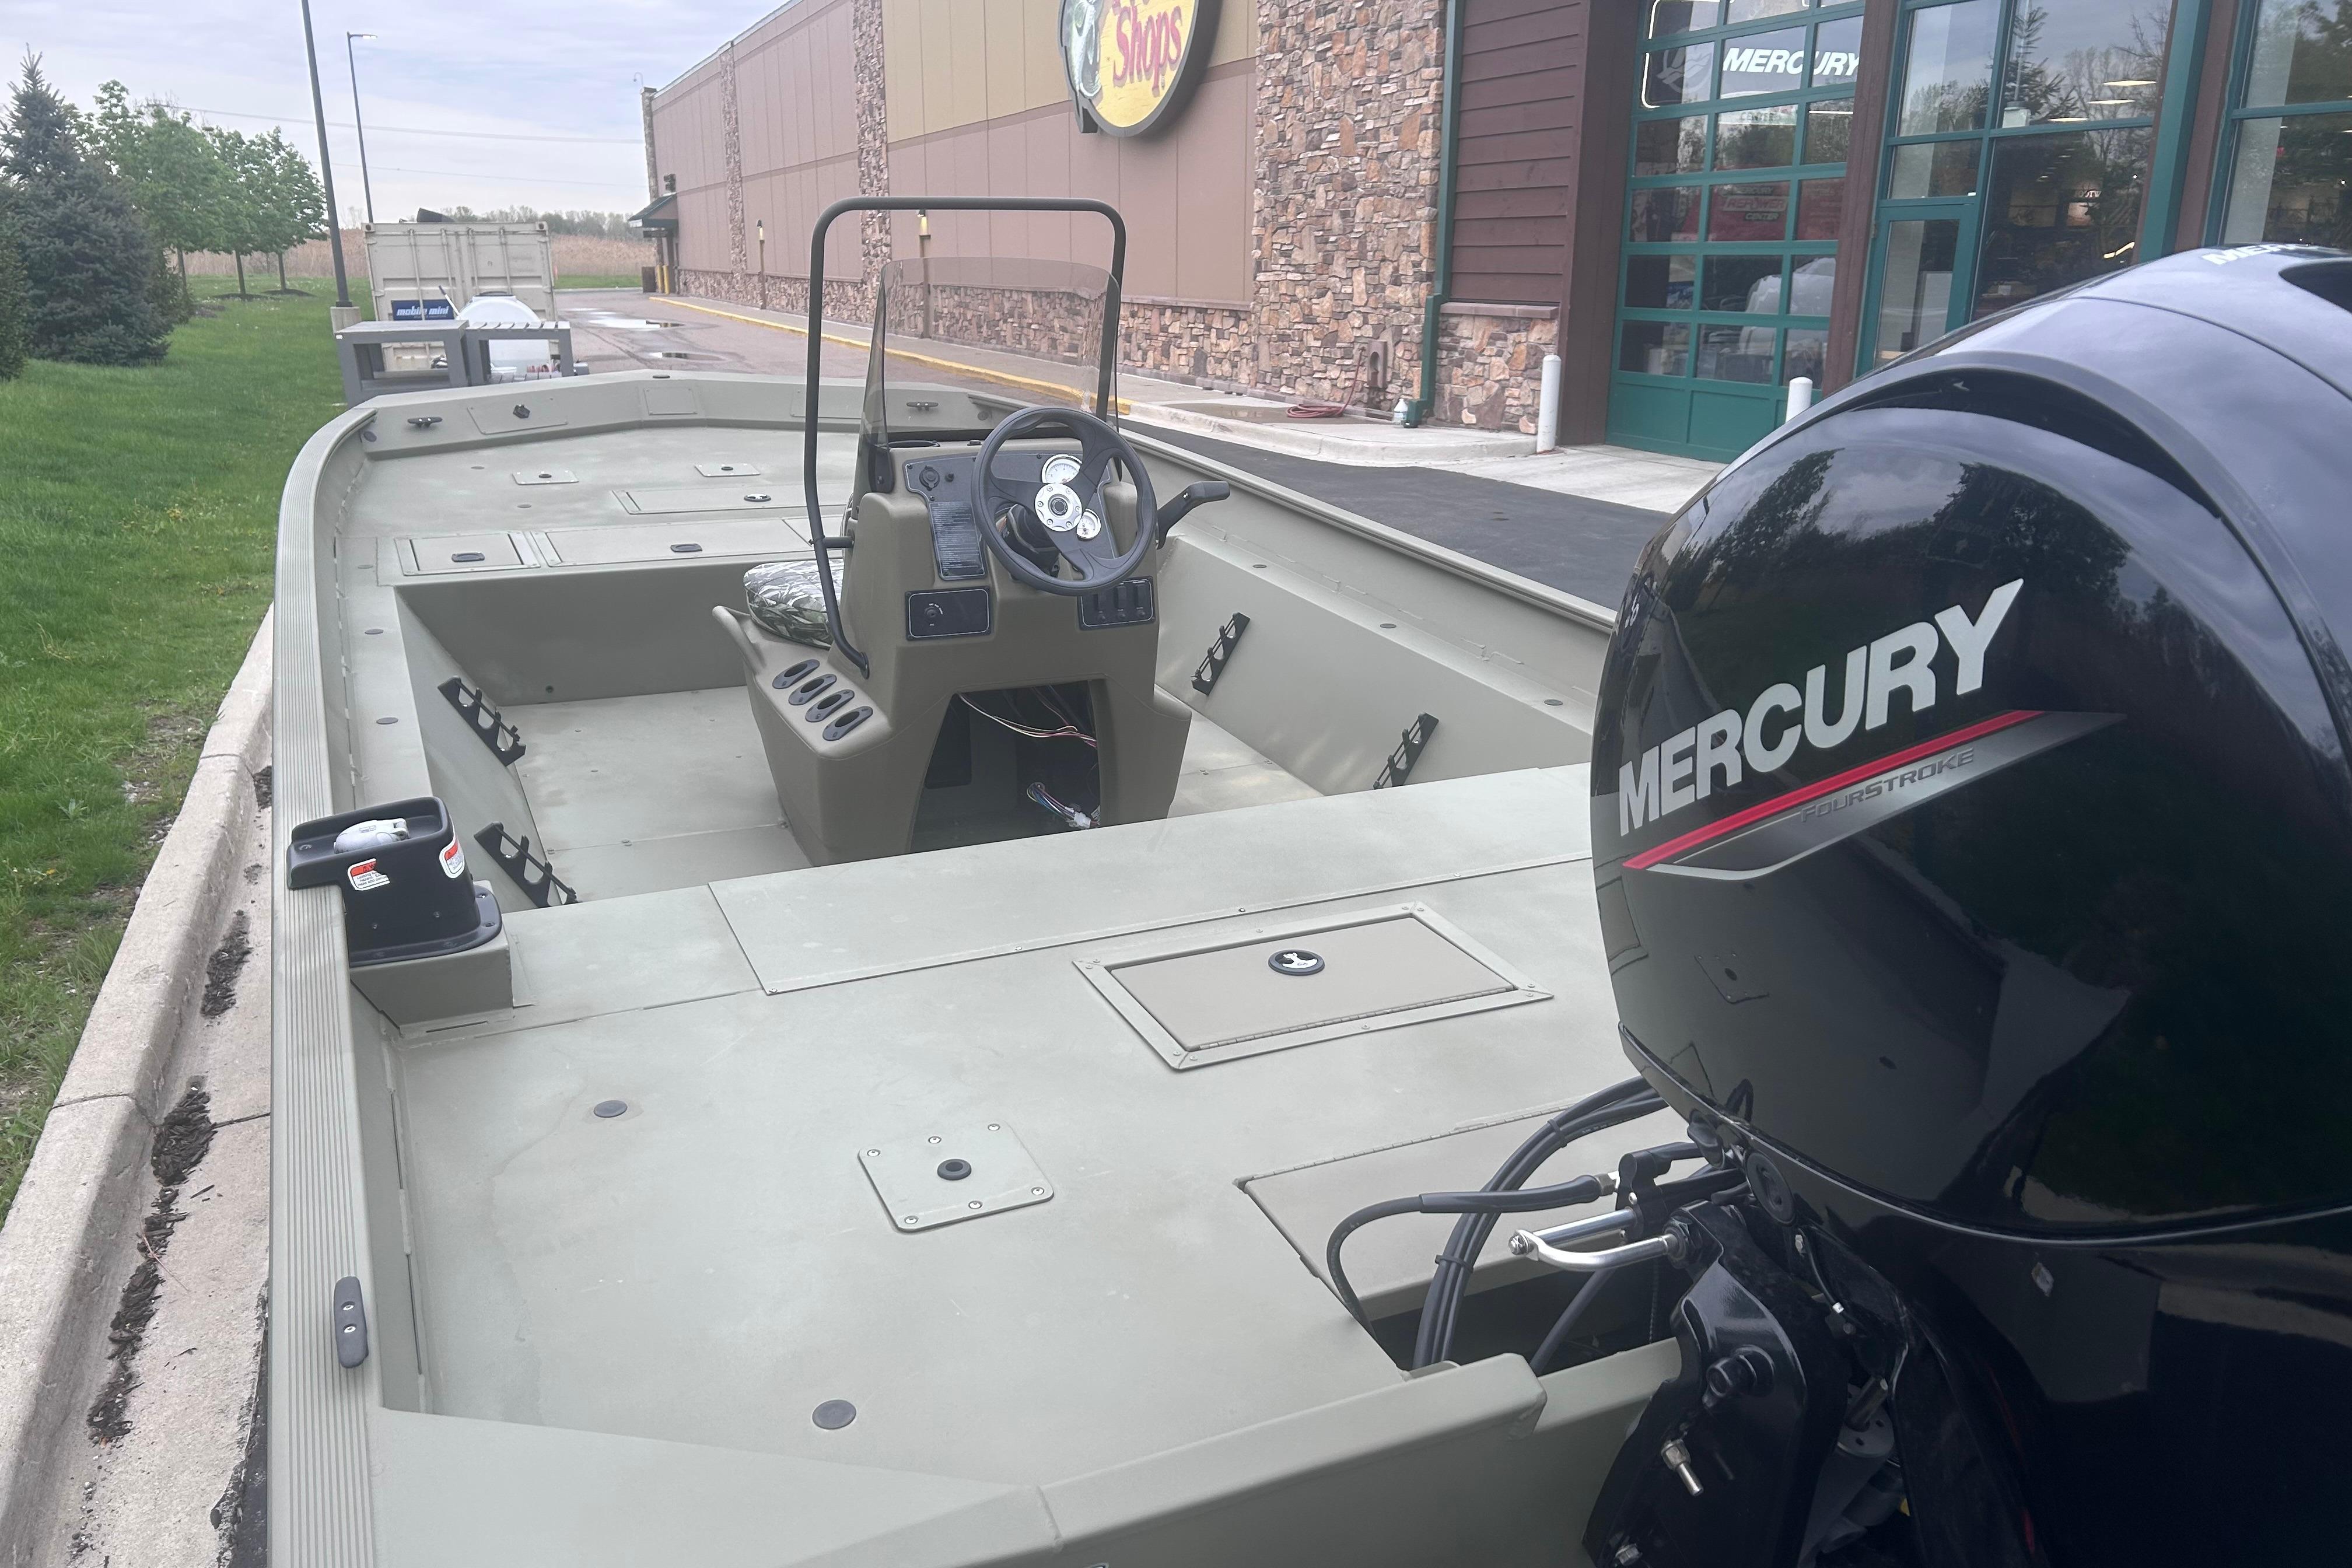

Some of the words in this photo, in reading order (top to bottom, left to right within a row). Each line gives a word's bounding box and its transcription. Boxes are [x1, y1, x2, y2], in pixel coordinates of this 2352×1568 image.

[1113, 6, 1183, 89] Shops
[1723, 47, 1859, 75] MERCURY
[397, 306, 428, 316] mobie
[429, 306, 449, 315] mini
[1619, 578, 2024, 836] MERCURY
[1801, 747, 1973, 822] FOURSTROKE
